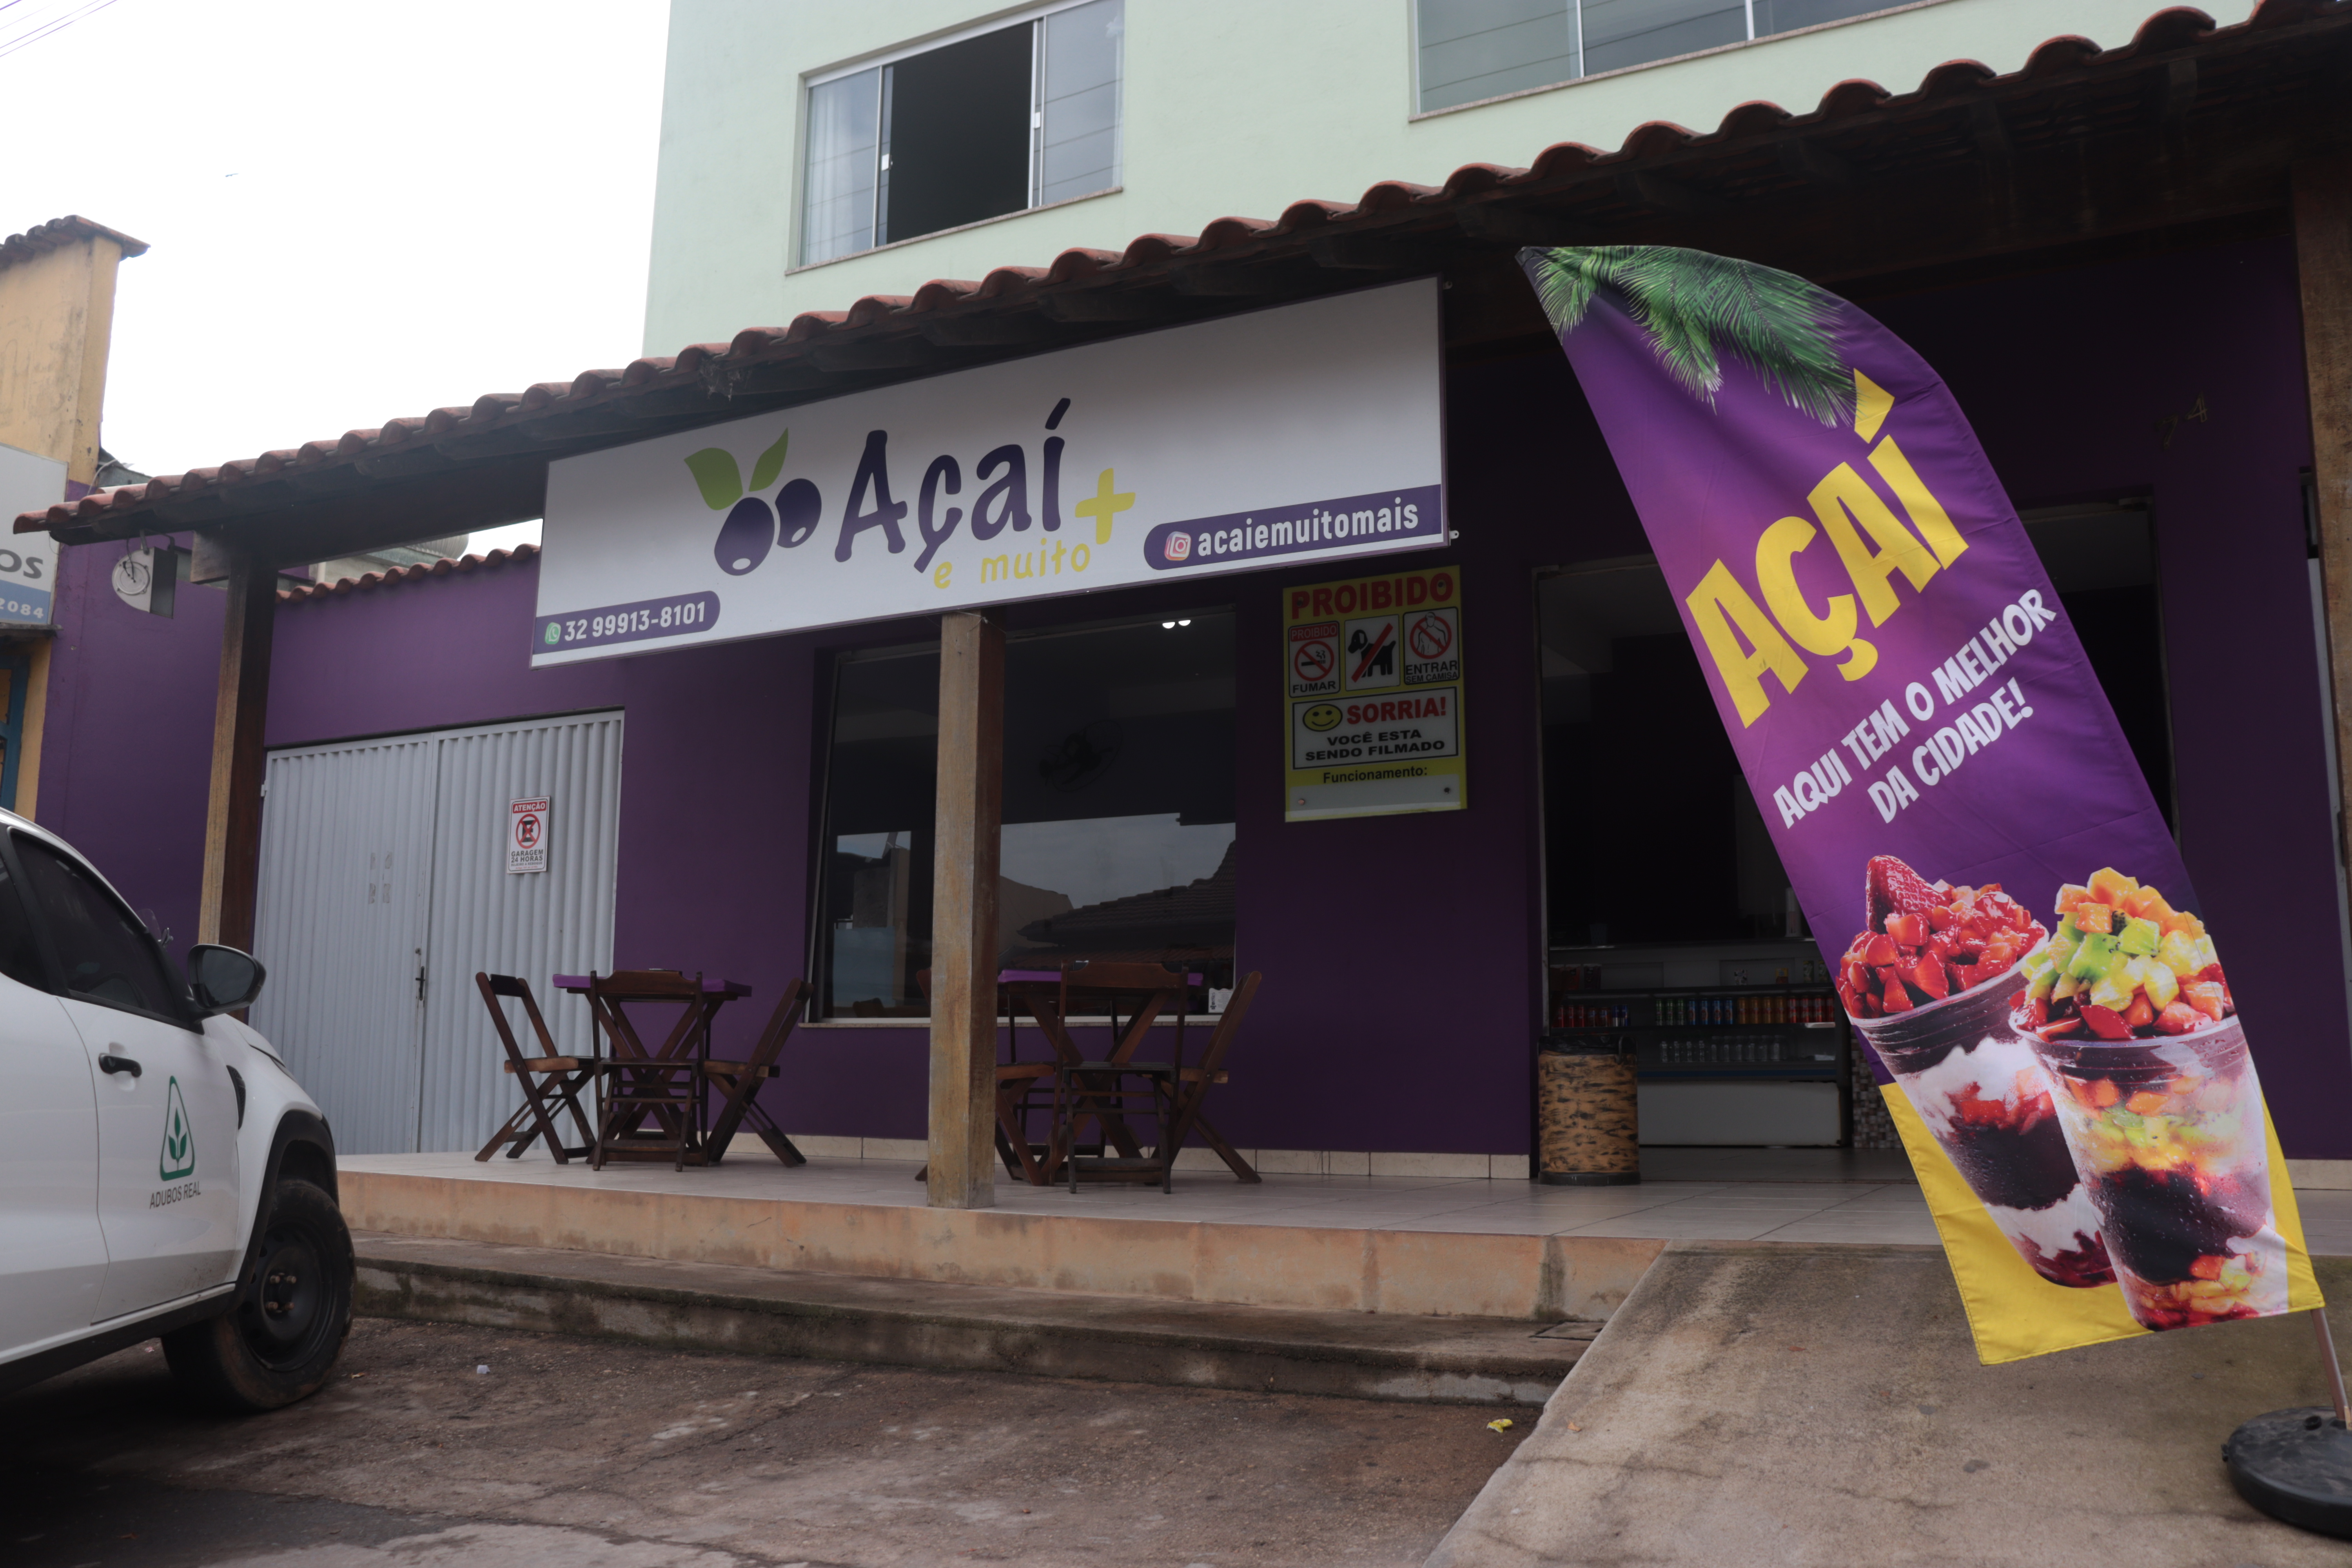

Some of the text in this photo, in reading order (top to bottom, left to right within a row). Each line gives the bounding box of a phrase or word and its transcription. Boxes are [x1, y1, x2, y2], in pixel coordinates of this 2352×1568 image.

[835, 397, 1071, 573] Açaí
[1198, 497, 1419, 556] acaiemuitomais
[1685, 367, 1969, 729] AÇAÍ
[934, 561, 953, 589] e
[980, 538, 1090, 584] muito
[1292, 573, 1453, 619] PROIBIDO
[565, 601, 705, 641] 32 99913-8101
[1291, 624, 1337, 639] PROIBIDO
[1406, 660, 1457, 675] ENTRAR
[1406, 671, 1457, 684] SEM CAMISA
[1293, 681, 1336, 693] FUMAR
[1347, 697, 1446, 724] SORRIA!
[1773, 589, 2057, 829] AQUI TEM O MELHOR
[1306, 740, 1445, 761] SENDO FILMADO
[1327, 730, 1421, 746] VOCÊ ESTA
[1867, 677, 2034, 823] DA CIDADE!
[1323, 766, 1427, 783] Funcionamento:
[514, 802, 545, 811] ATENÇÃO
[150, 1181, 201, 1209] ADUBOS REAL
